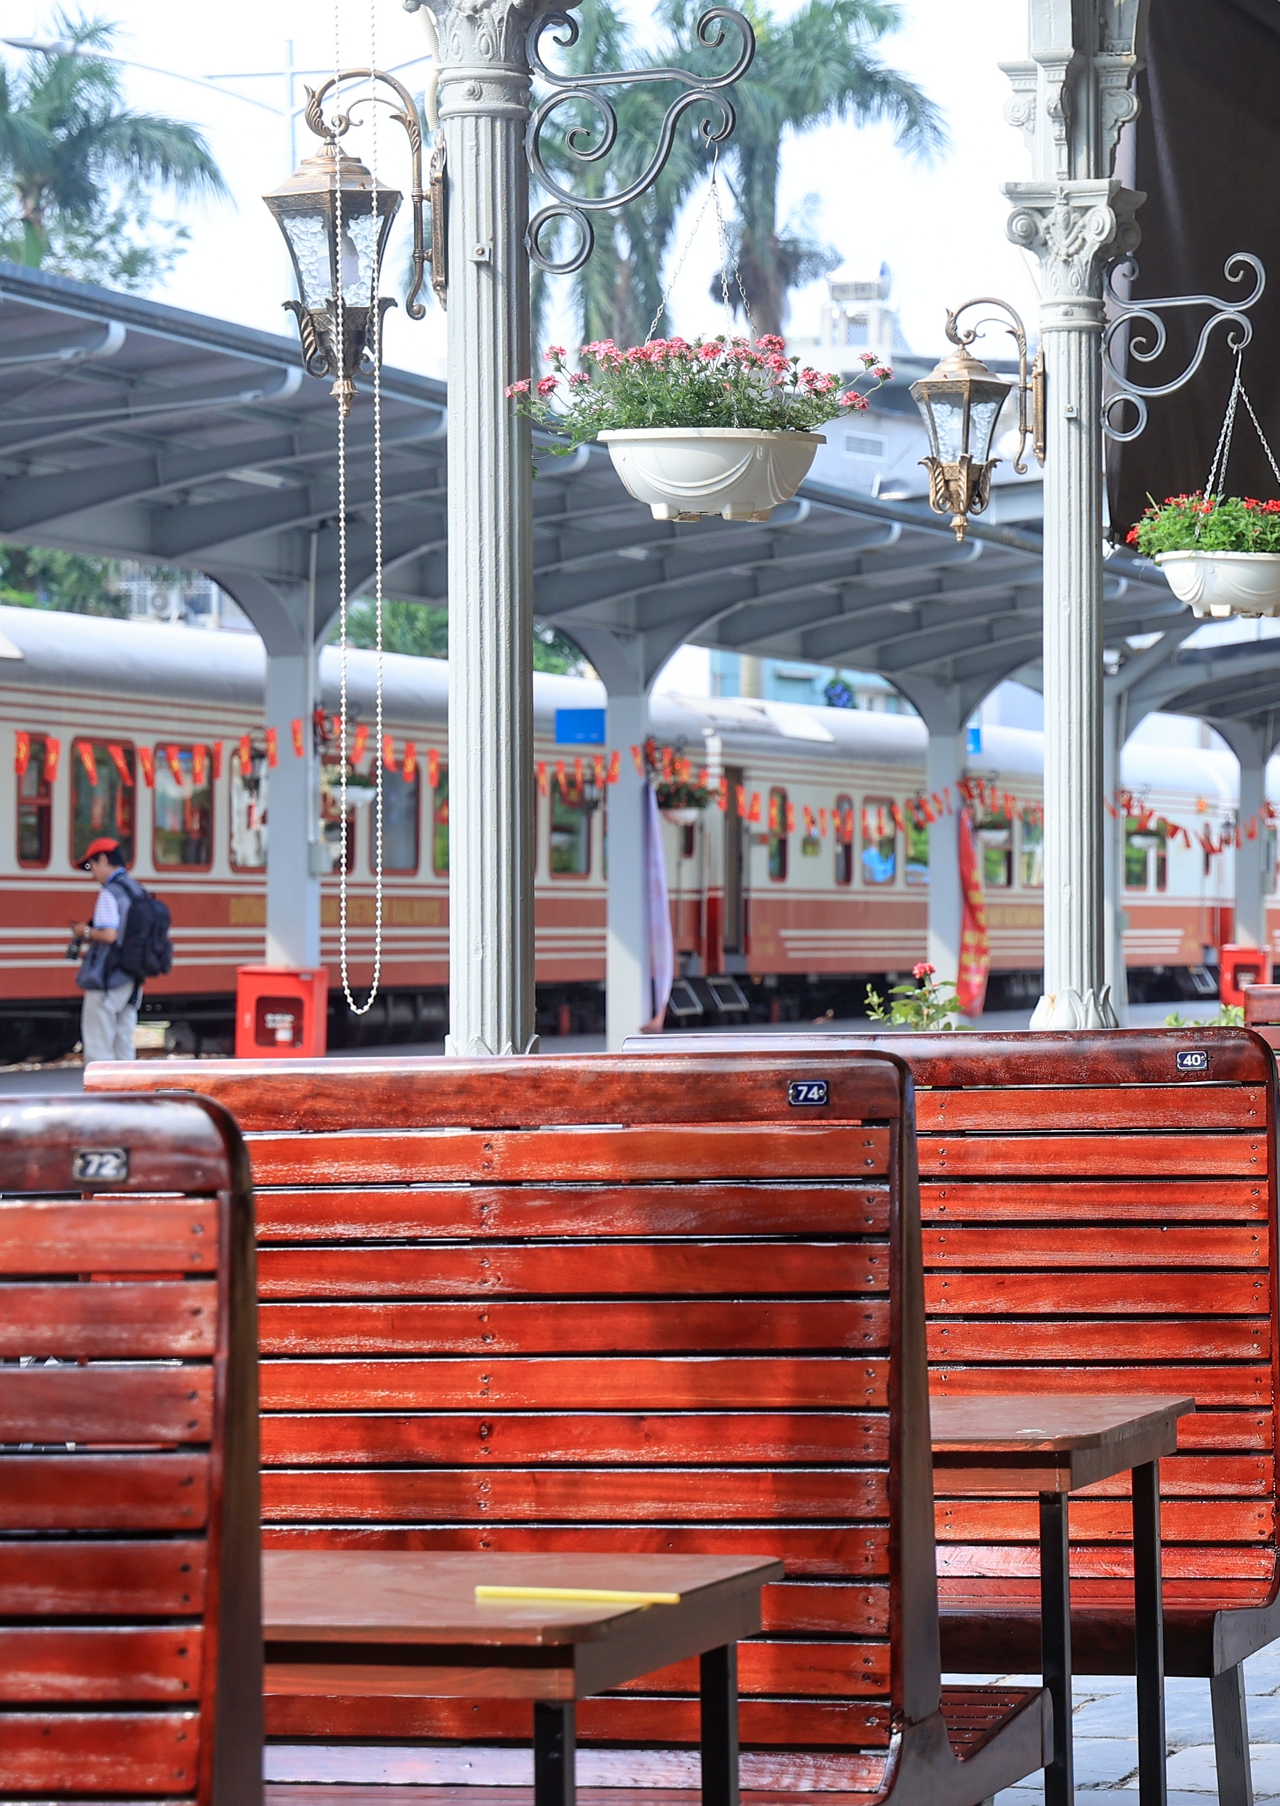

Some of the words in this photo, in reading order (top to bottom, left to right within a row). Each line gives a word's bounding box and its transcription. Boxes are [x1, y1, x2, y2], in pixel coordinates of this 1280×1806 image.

[1183, 1054, 1200, 1066] 40
[797, 1086, 819, 1100] 74
[86, 1155, 118, 1176] 72
